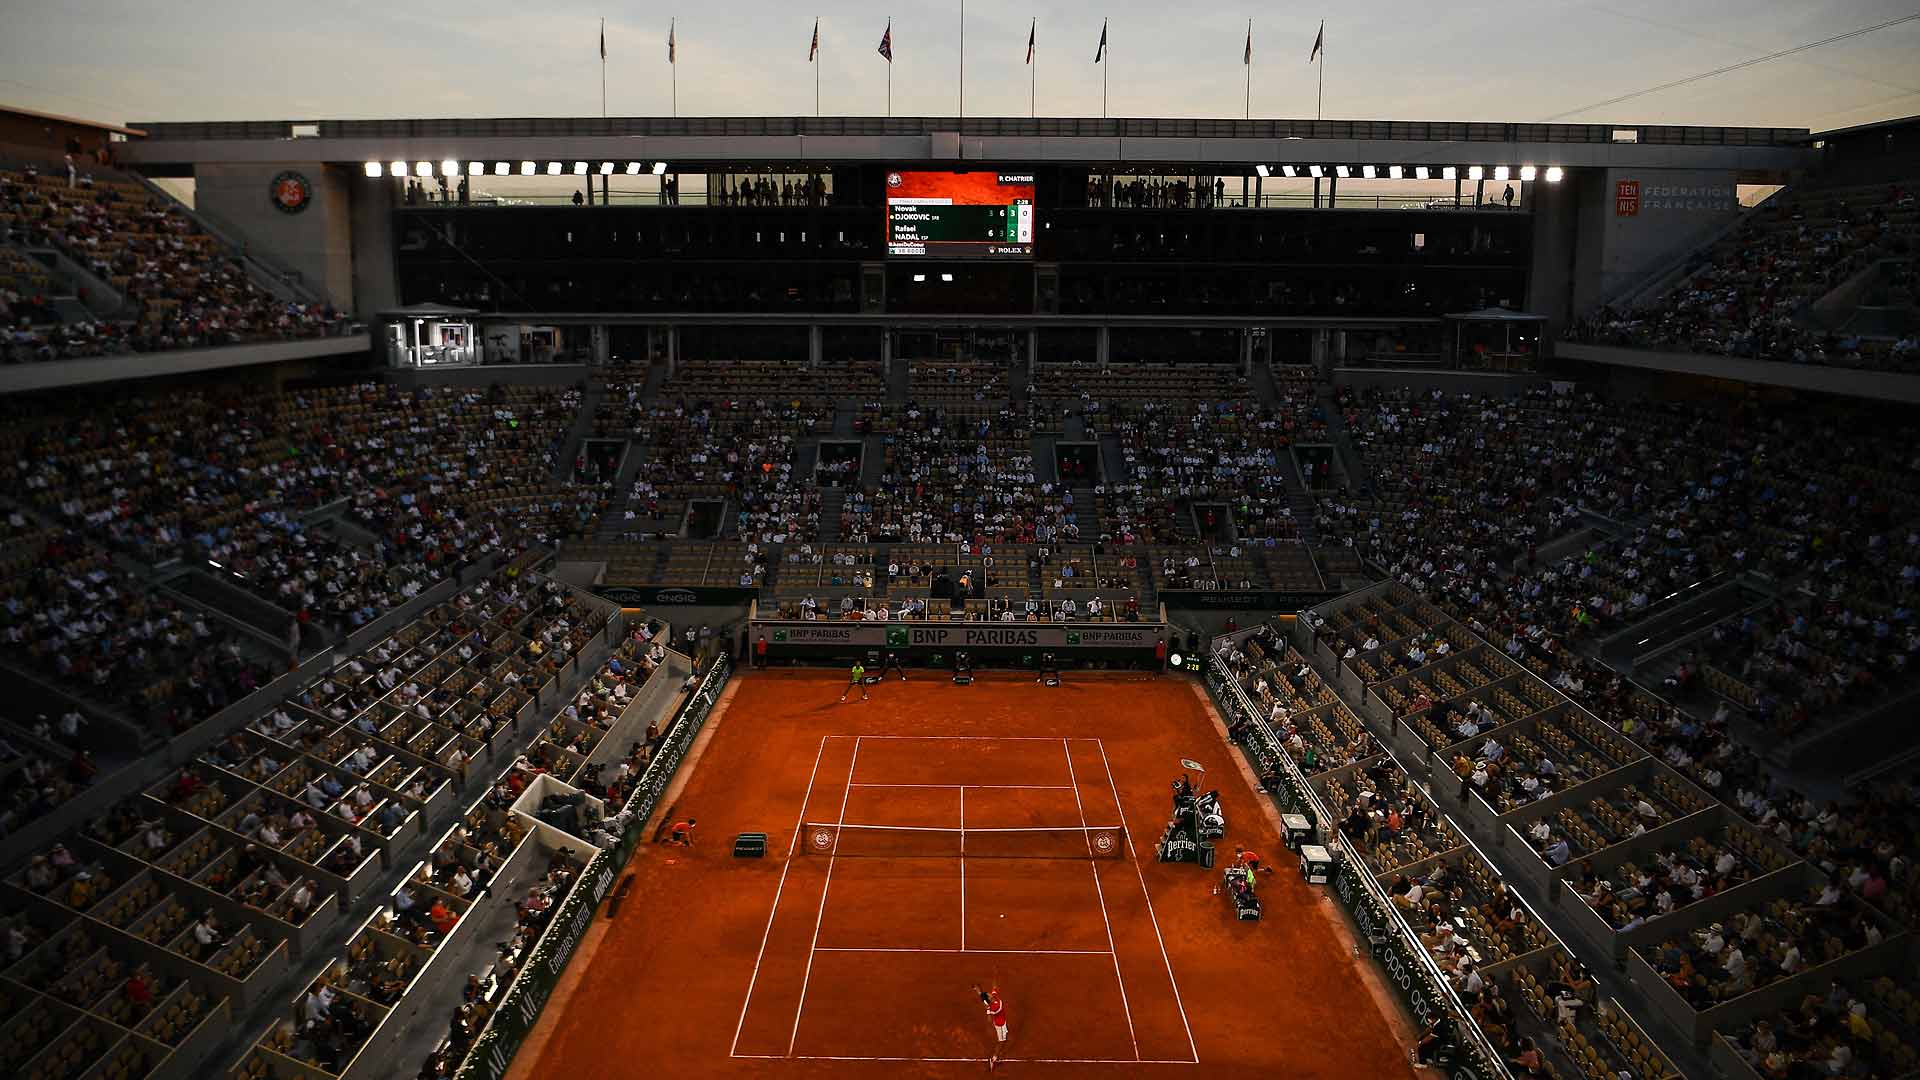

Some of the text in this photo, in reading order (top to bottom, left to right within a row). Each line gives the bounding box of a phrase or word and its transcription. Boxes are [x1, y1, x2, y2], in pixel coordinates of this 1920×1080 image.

[1620, 185, 1636, 195] TEN
[1619, 201, 1636, 212] NIS
[790, 629, 850, 640] BNP PARIBAS
[913, 629, 1037, 644] BNP PARIBAS
[1082, 632, 1143, 641] BNP PARIBAS
[1167, 838, 1197, 857] perrier
[548, 933, 574, 976] Emirates
[1384, 946, 1411, 992] oppo
[1410, 989, 1433, 1026] opp
